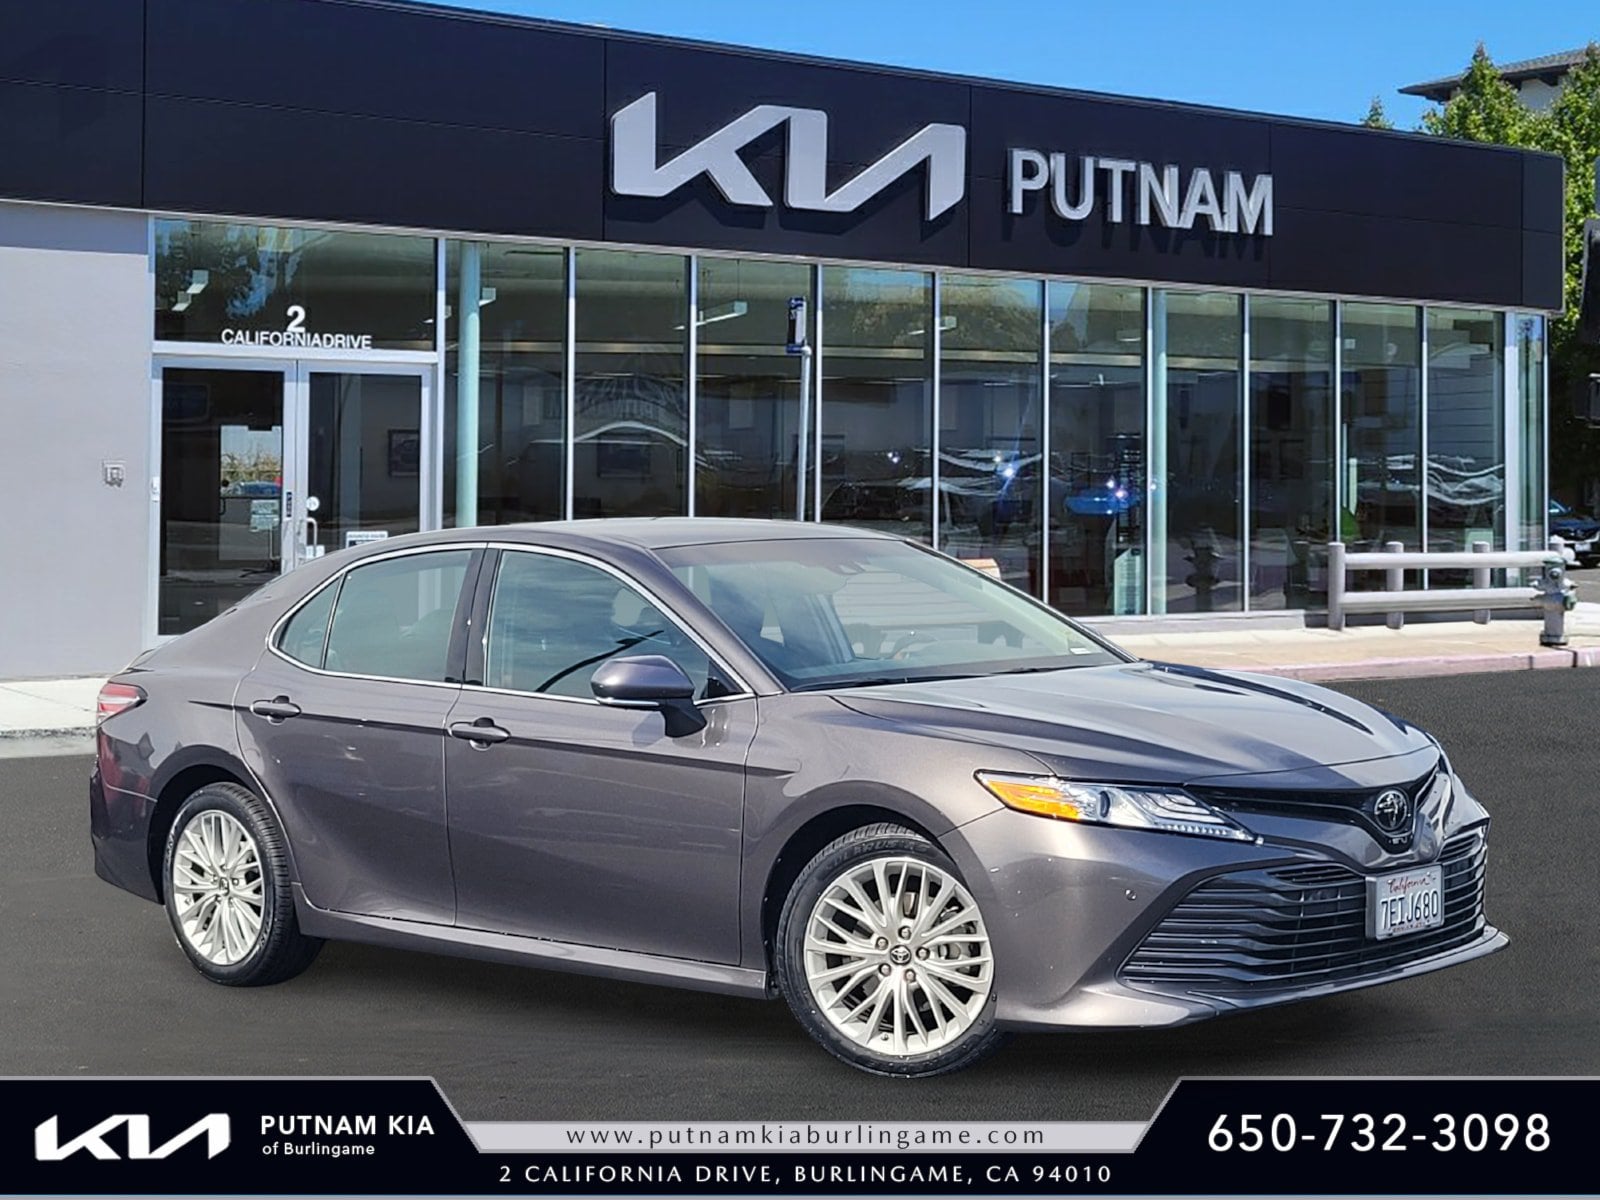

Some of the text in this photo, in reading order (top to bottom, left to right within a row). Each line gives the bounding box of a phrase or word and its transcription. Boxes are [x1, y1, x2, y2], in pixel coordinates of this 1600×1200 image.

[610, 91, 1274, 237] KIA PUTNAM
[286, 305, 306, 333] 2
[1380, 889, 1439, 931] 7EIJ680
